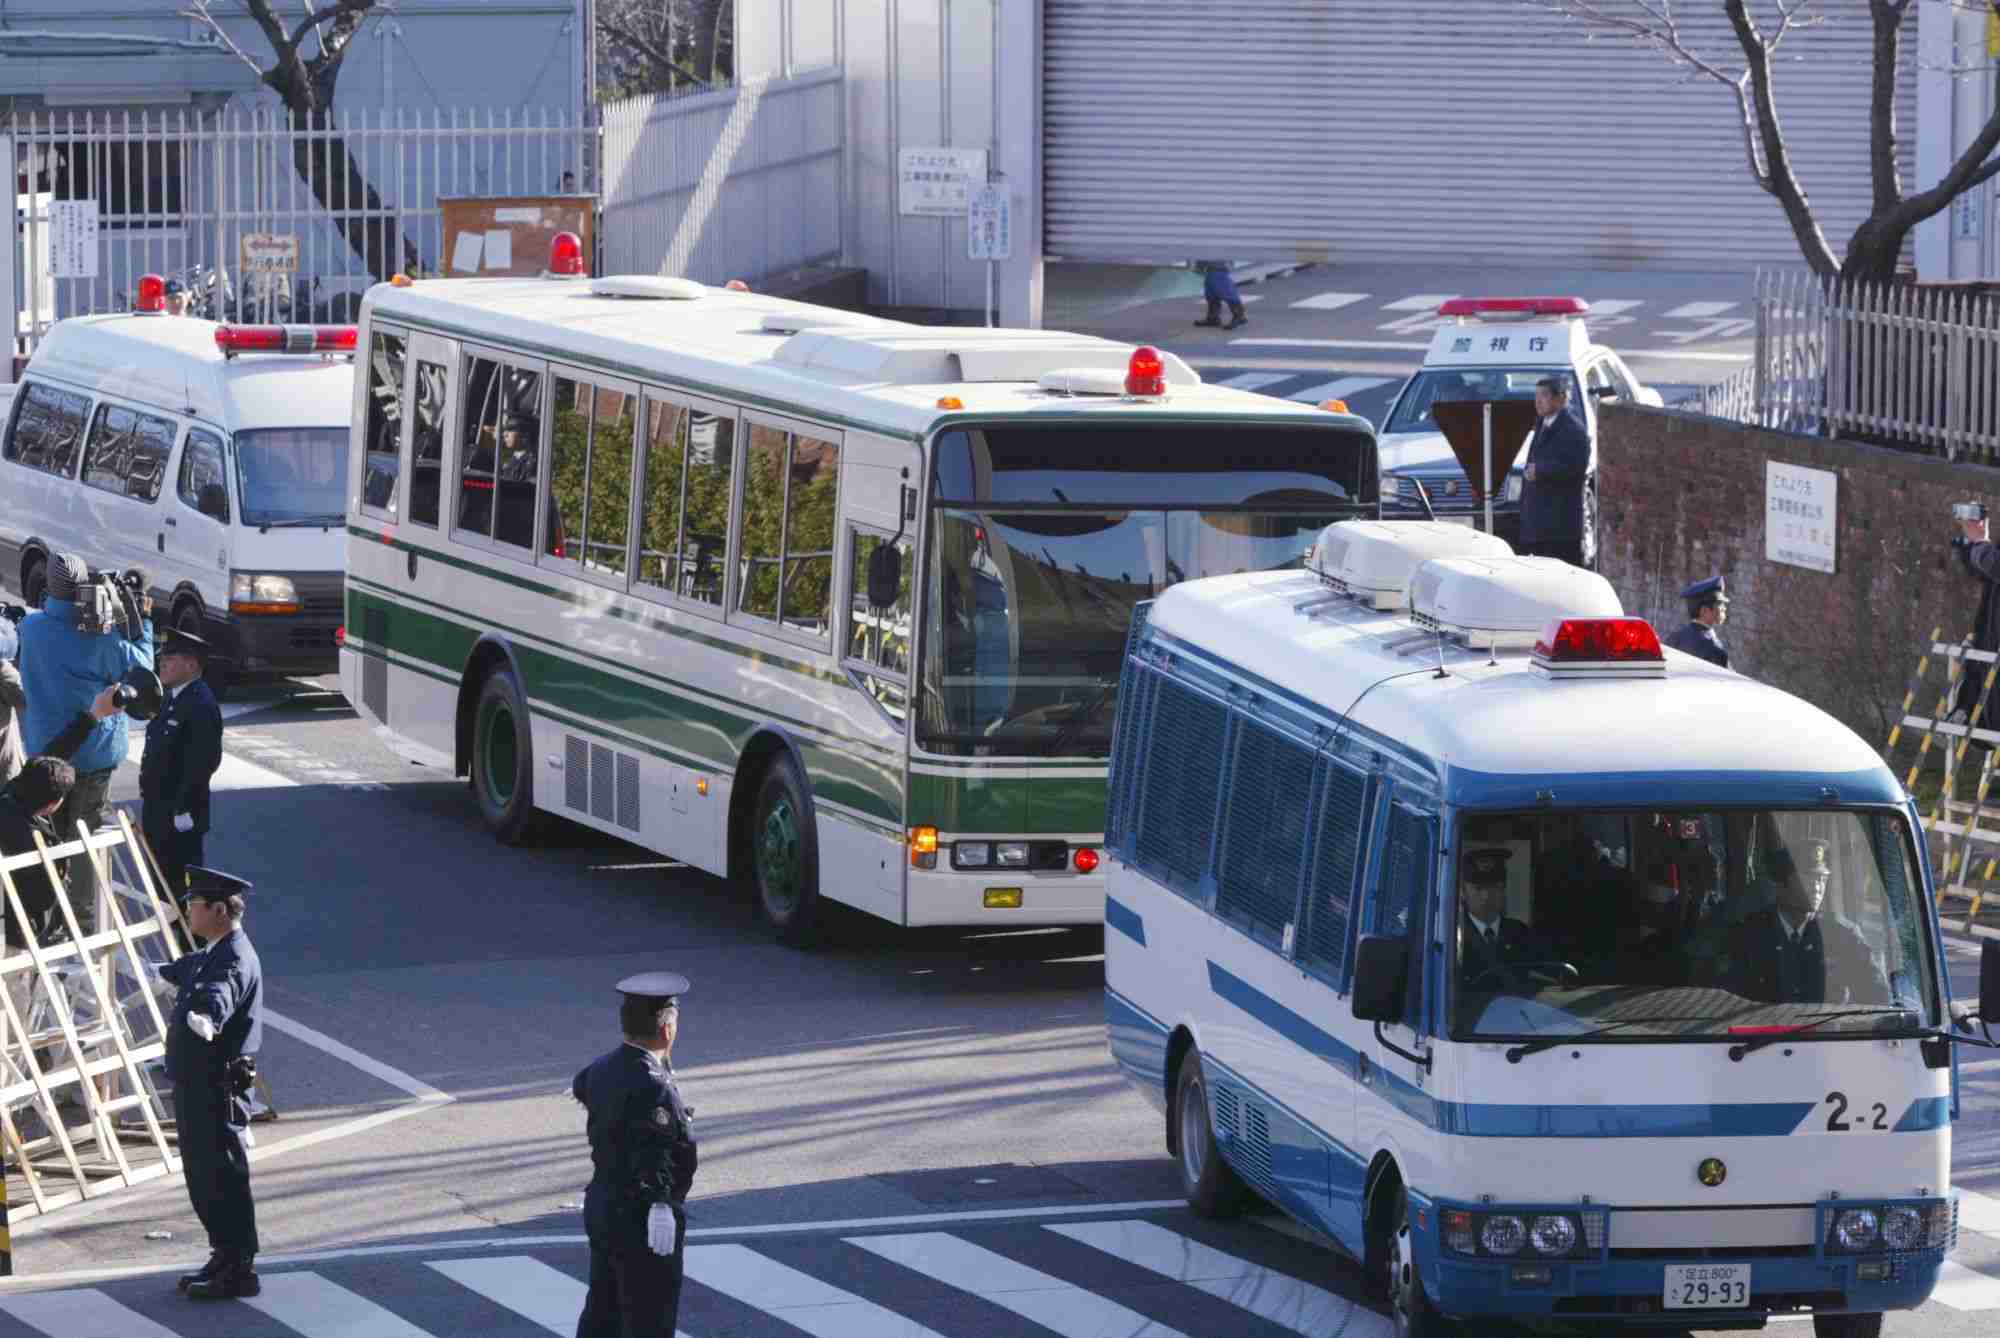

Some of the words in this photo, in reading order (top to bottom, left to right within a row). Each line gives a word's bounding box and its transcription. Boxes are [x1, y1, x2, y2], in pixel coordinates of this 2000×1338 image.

[1450, 336, 1549, 353] 警視庁
[1774, 474, 1813, 497] これより先
[1824, 1091, 1889, 1132] 2-2
[1681, 1282, 1745, 1305] 29-93
